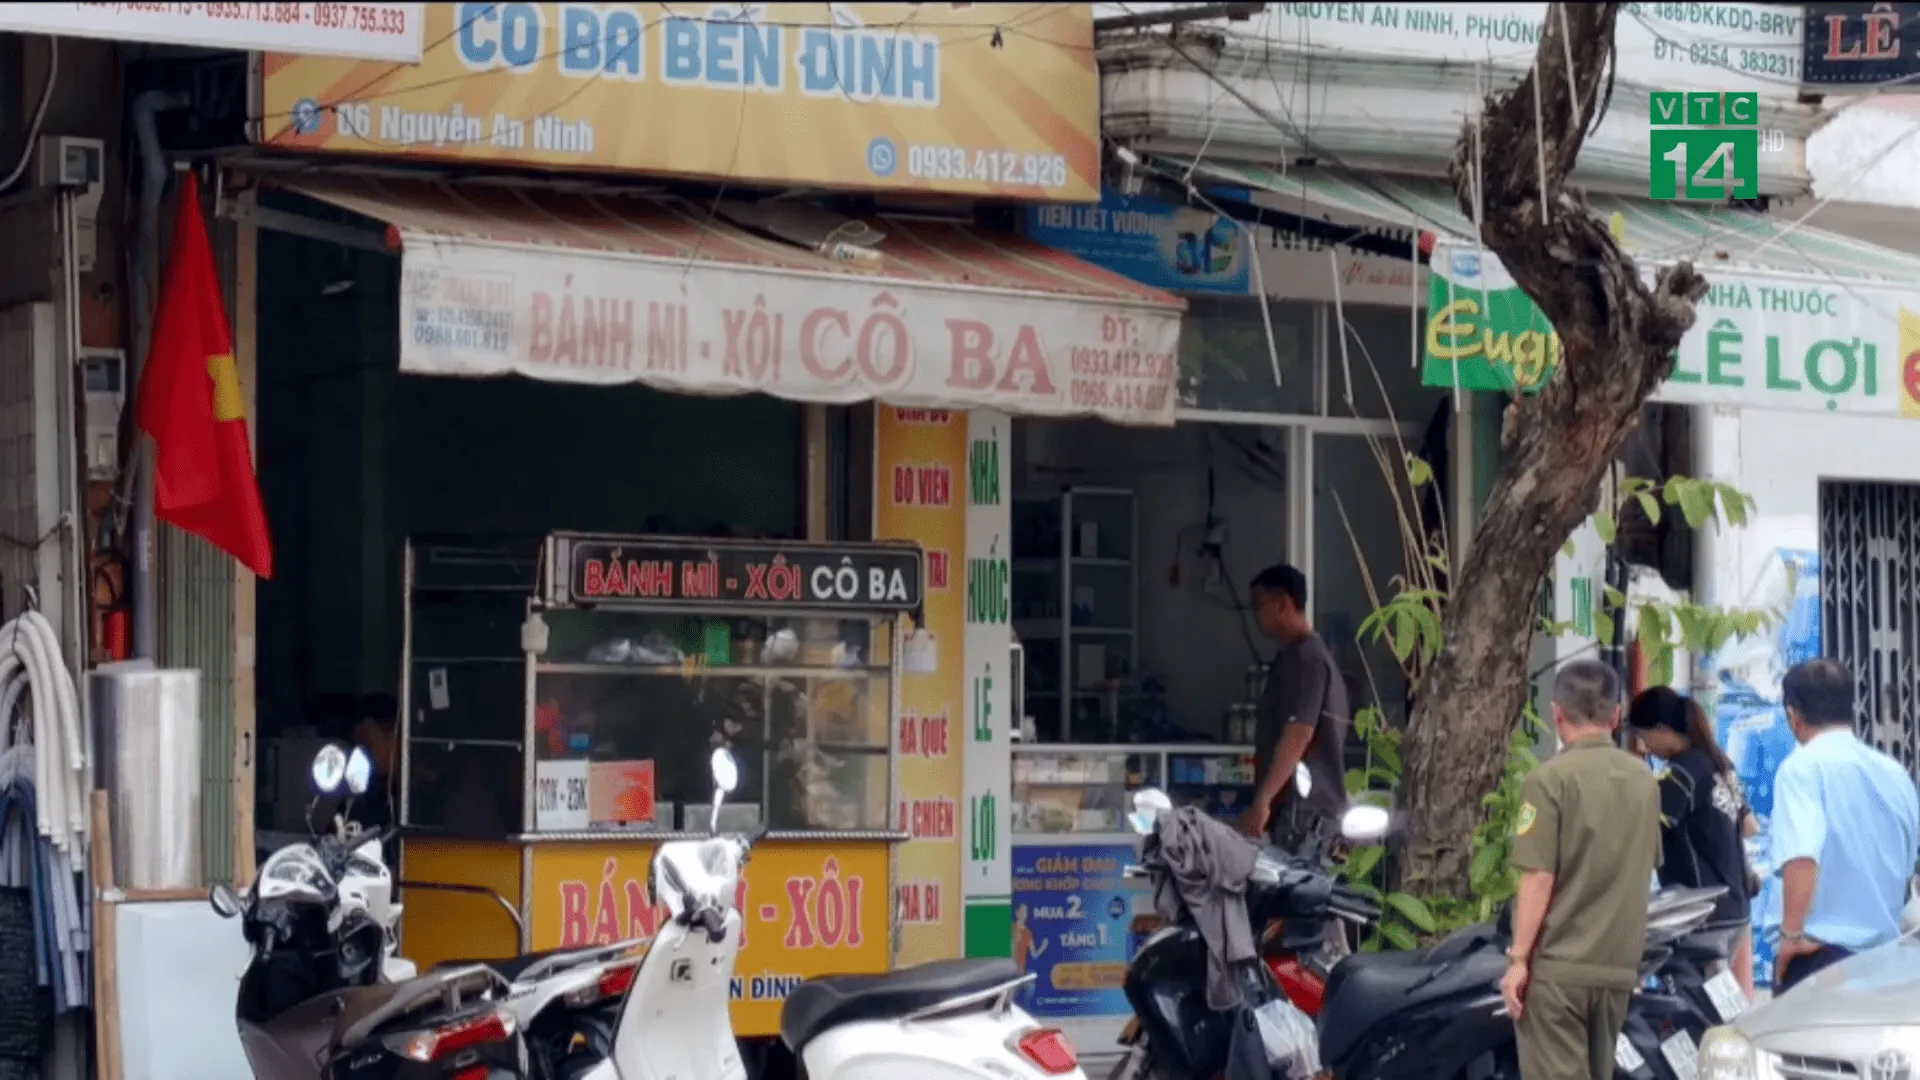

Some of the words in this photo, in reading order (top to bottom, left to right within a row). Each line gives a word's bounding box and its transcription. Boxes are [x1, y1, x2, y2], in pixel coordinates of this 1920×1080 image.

[313, 6, 405, 34] 0937.755.333
[1371, 10, 1398, 29] AN
[1404, 12, 1460, 39] NINH,
[1822, 3, 1900, 62] LÊ
[562, 3, 642, 77] BA
[664, 6, 781, 89] BẾN
[798, 7, 937, 101] ĐÌNH
[379, 102, 481, 148] Nguyễn
[489, 113, 525, 148] An
[532, 114, 595, 154] Ninh
[908, 144, 1068, 188] 0933.412.926
[1701, 280, 1753, 310] NHÀ
[528, 272, 634, 371] BÁNH
[647, 281, 689, 372] MÌ
[722, 292, 783, 383] XÔI
[799, 289, 911, 386] CÔ
[944, 317, 1057, 395] BA
[1101, 314, 1138, 346] ĐT:
[1670, 317, 1745, 388] LÊ
[1765, 335, 1878, 412] LỢI
[583, 544, 674, 597] BÁNH
[681, 548, 720, 598] MÌ
[743, 553, 801, 601] XÔI
[810, 555, 860, 601] CÔ
[867, 566, 909, 601] BA
[559, 857, 673, 948] BÁN
[784, 856, 863, 948] XÔI
[1066, 895, 1083, 920] 2
